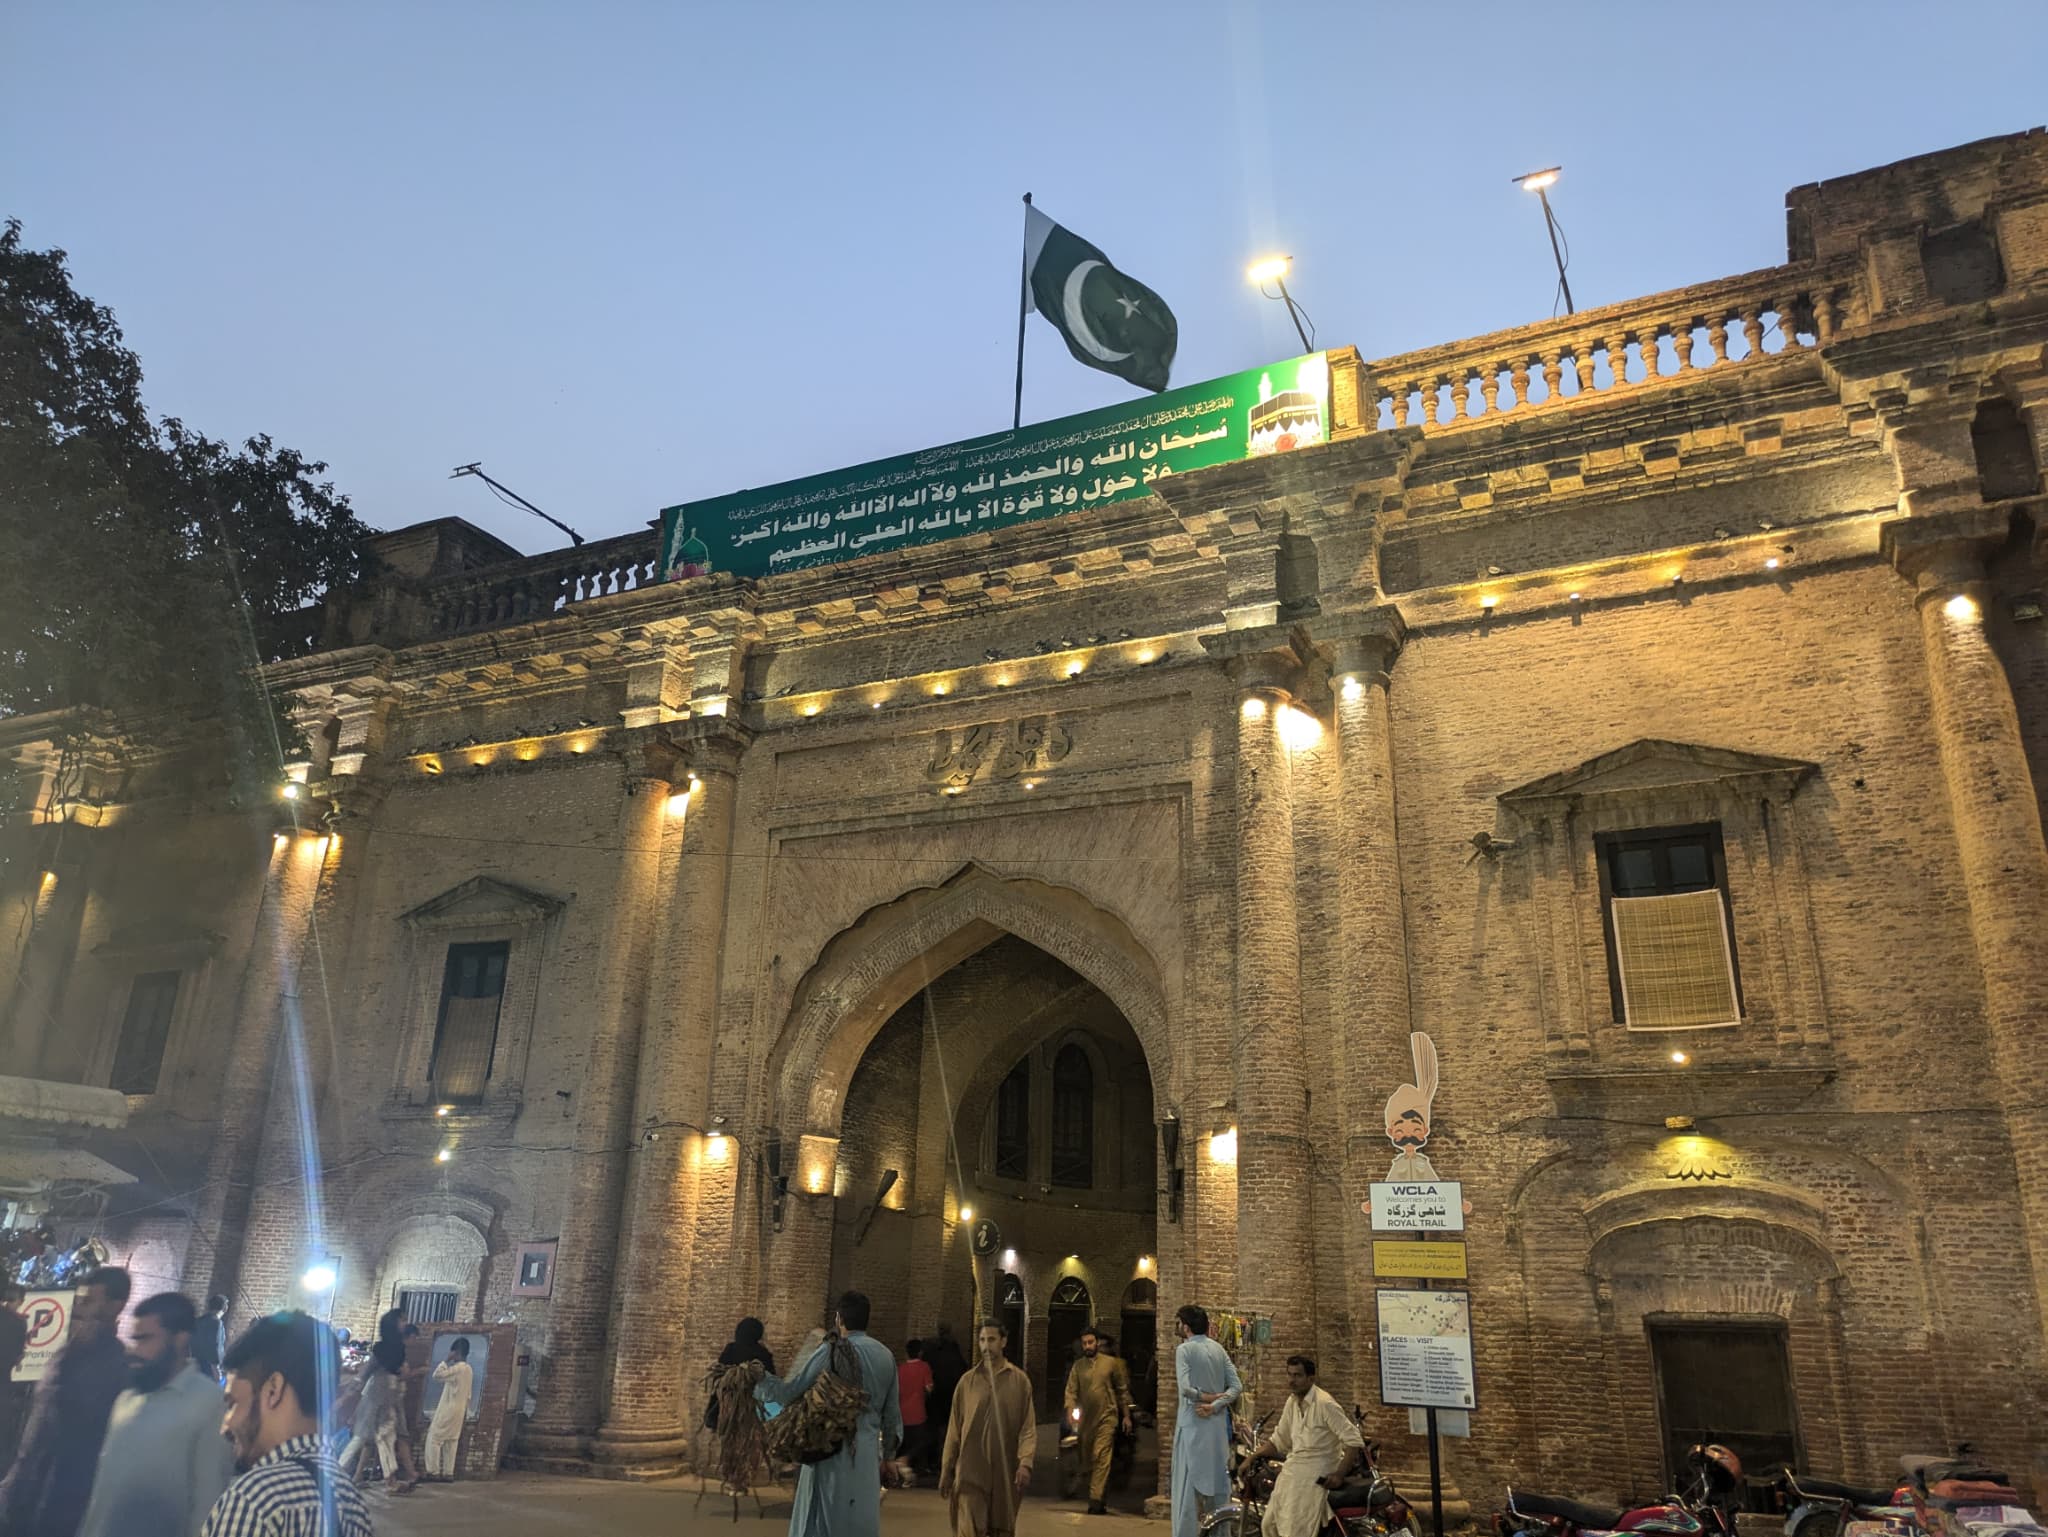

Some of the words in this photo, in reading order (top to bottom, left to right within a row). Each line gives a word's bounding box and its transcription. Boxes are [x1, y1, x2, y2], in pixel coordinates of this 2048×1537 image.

[1392, 1186, 1438, 1196] WCLA
[1387, 1219, 1418, 1227] ROYAL
[1420, 1219, 1447, 1227] TRAIL
[1416, 1337, 1433, 1345] VISIT
